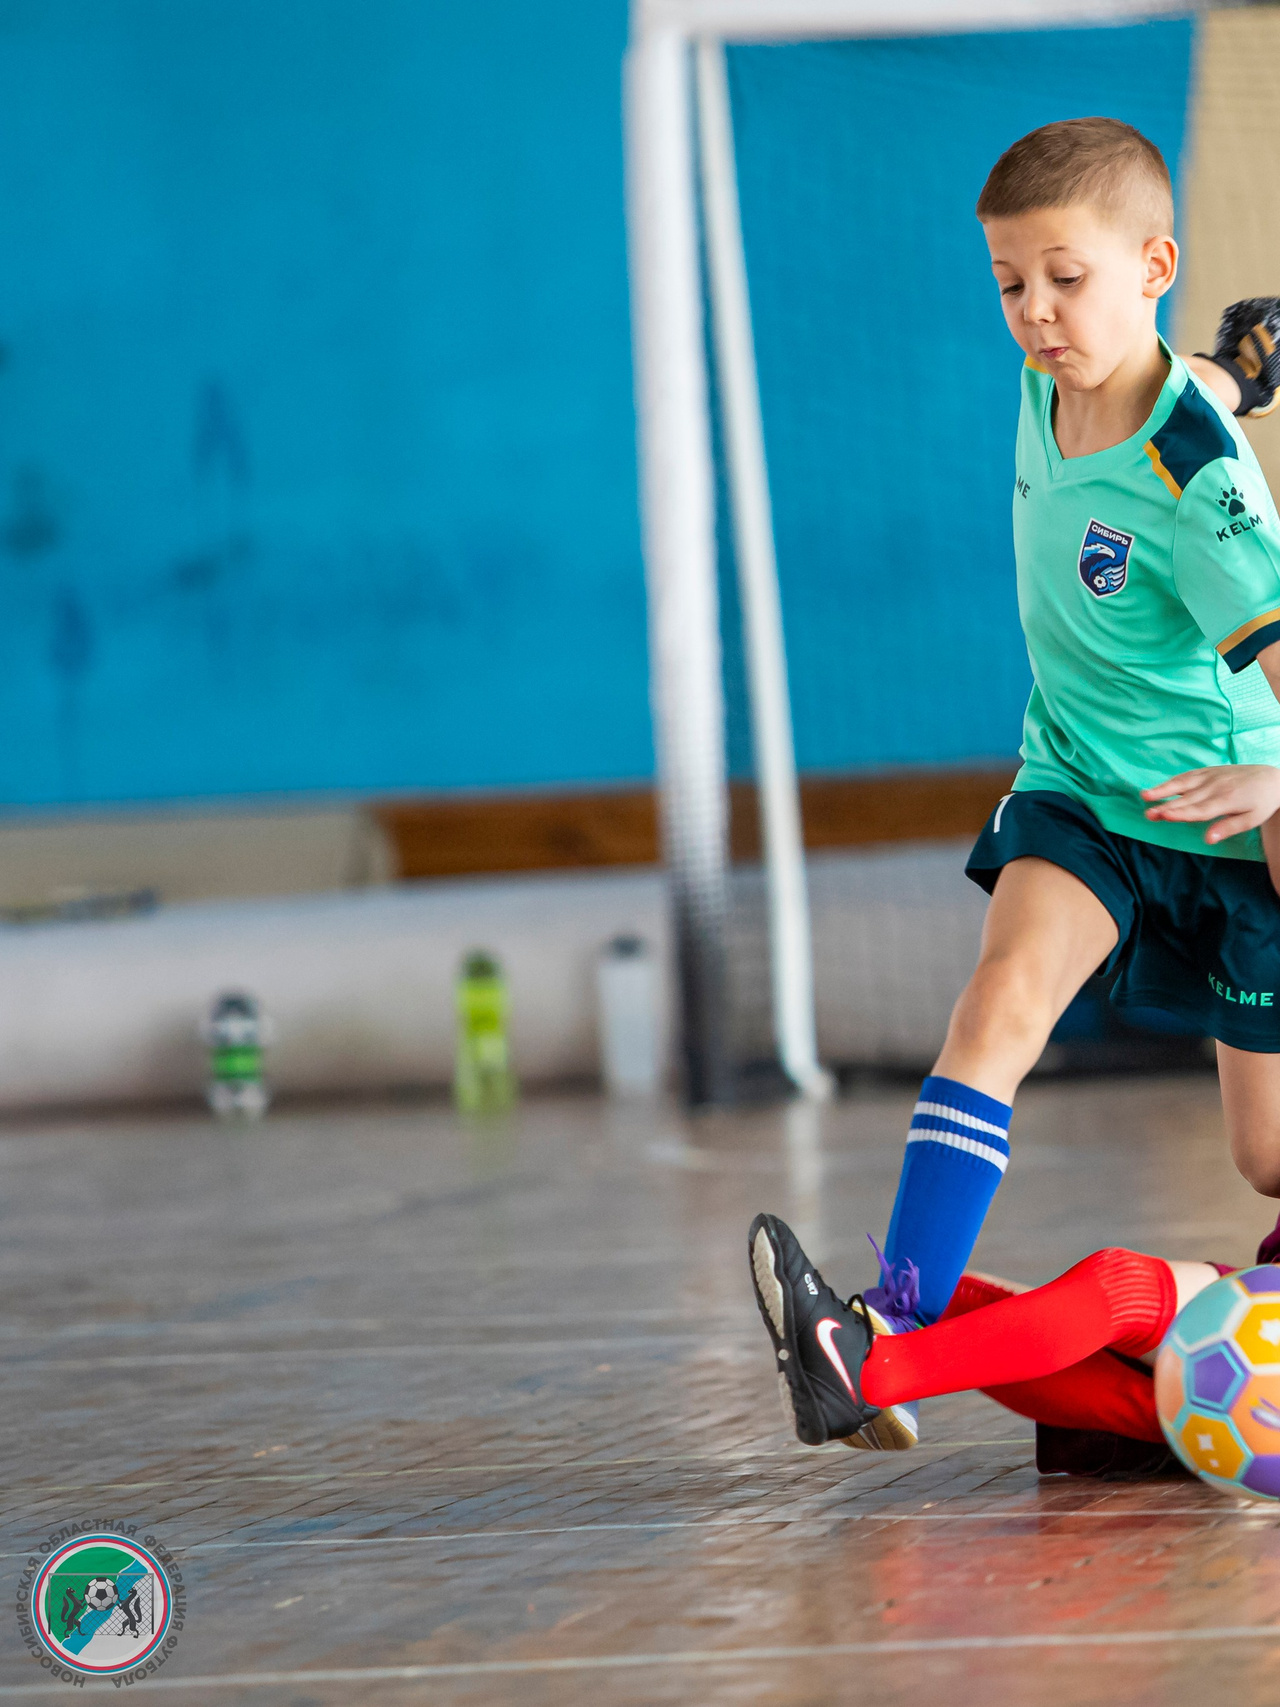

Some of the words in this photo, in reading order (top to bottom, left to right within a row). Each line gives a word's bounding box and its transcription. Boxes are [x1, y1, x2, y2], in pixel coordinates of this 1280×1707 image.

[1091, 524, 1129, 545] СИБИРЬ
[1216, 514, 1263, 542] KELM
[1208, 972, 1274, 1007] KELME
